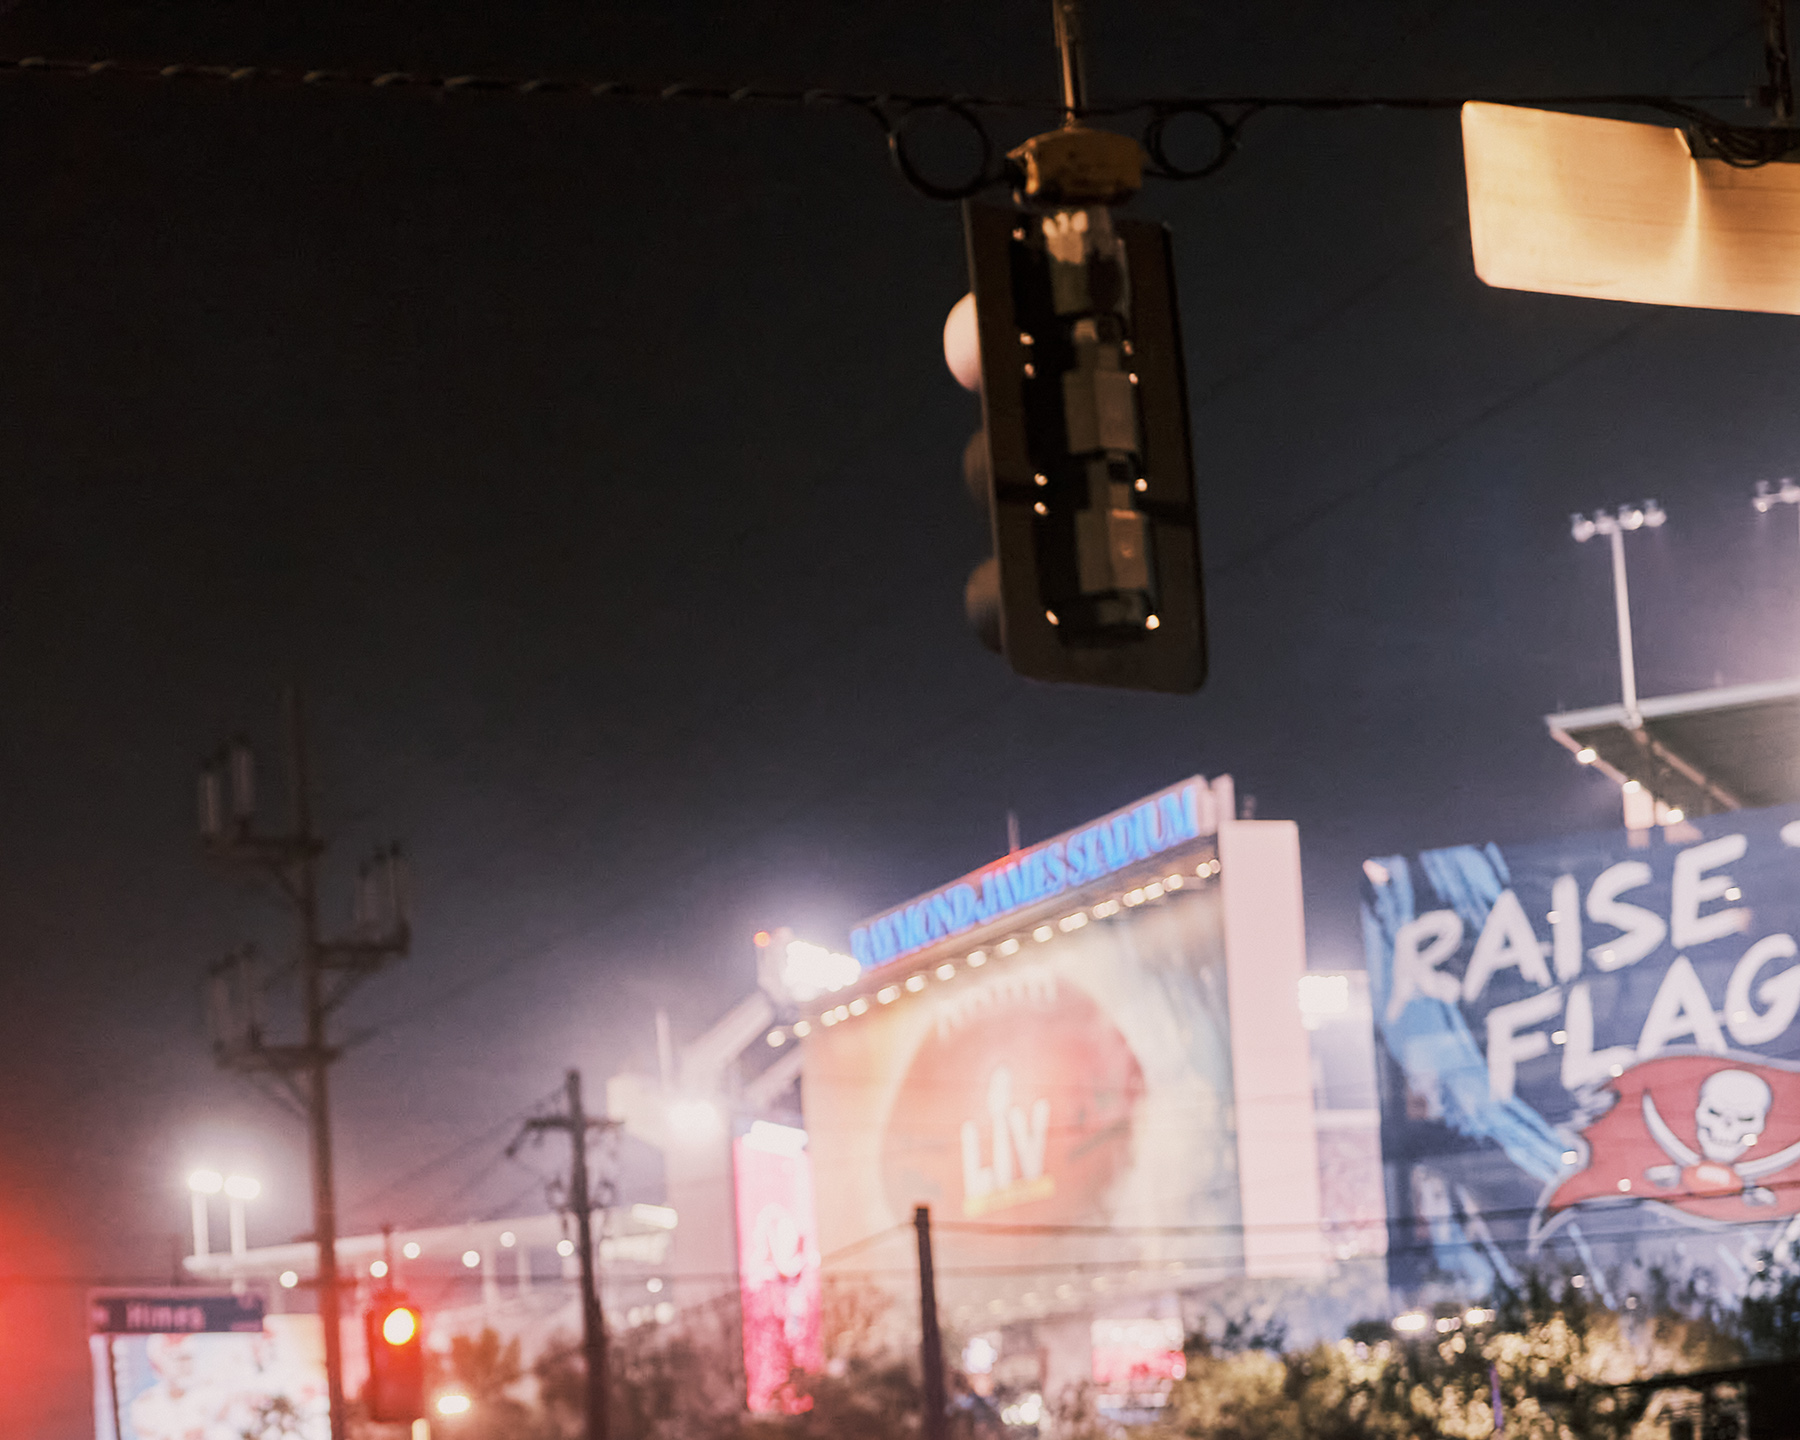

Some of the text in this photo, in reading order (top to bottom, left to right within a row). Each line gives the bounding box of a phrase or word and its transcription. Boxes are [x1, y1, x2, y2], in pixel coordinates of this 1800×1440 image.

[975, 843, 1067, 925] JAMES
[1066, 784, 1201, 888] STADIUM
[1386, 833, 1750, 1023] RAISE
[1486, 933, 1800, 1101] FLAG
